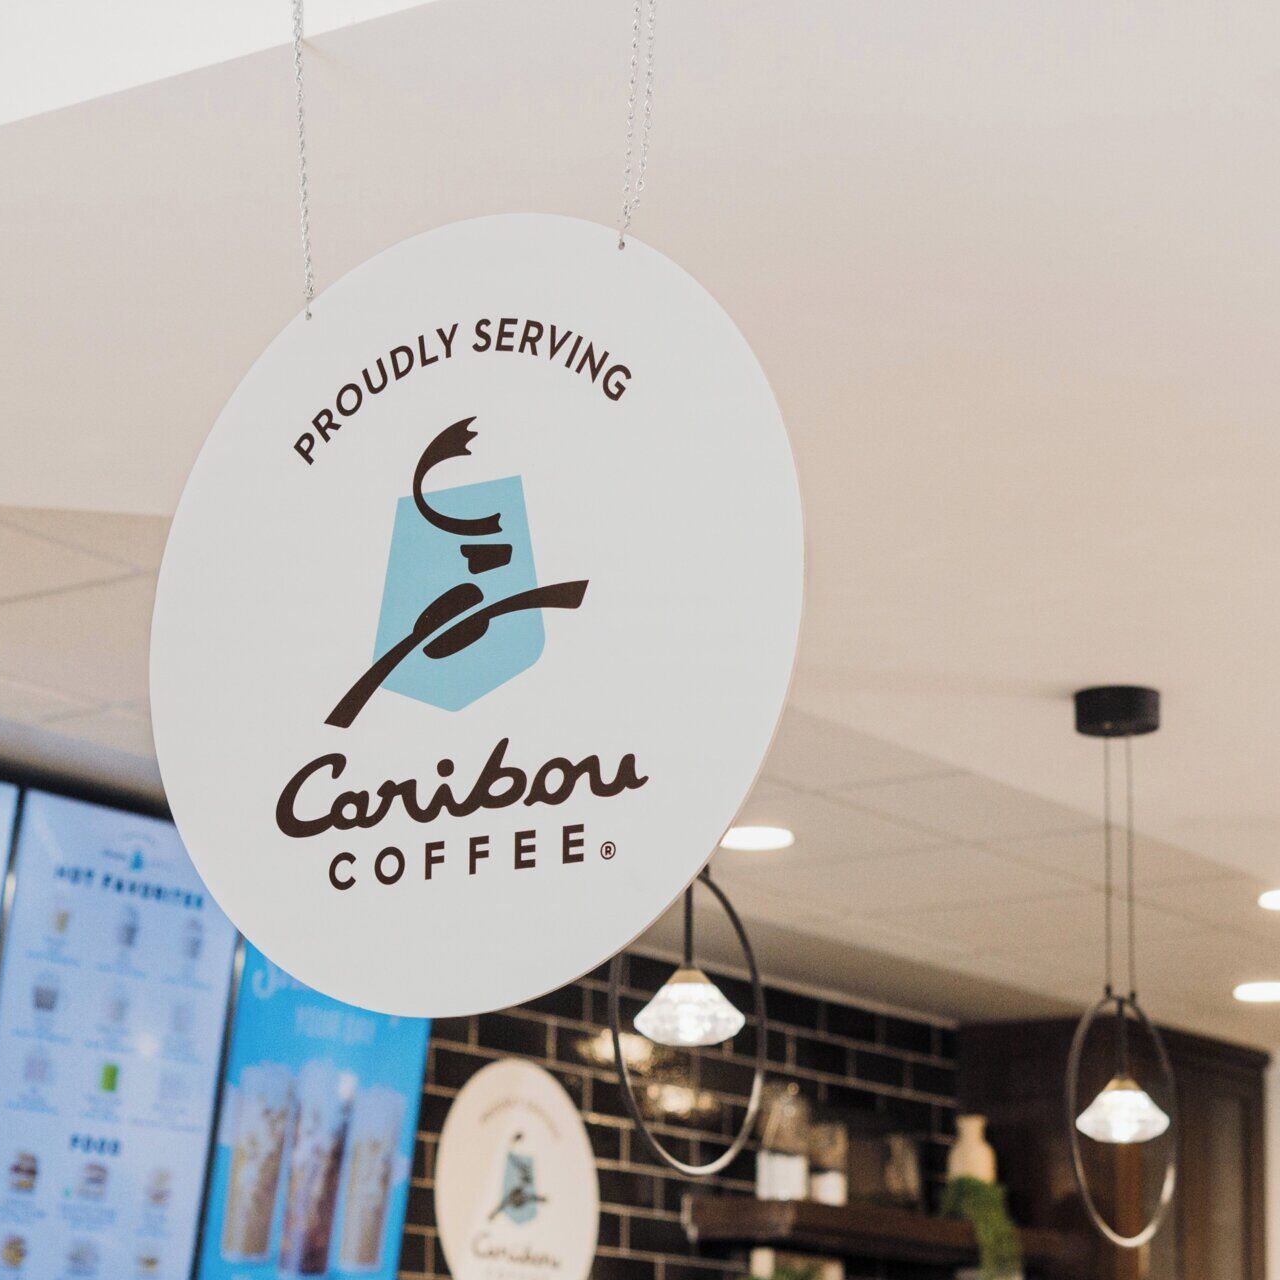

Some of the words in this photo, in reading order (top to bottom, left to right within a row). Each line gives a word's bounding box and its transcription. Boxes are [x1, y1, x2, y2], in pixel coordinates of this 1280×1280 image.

[293, 322, 459, 466] PROUDLY
[471, 317, 633, 402] SERVING
[275, 737, 649, 839] Caribou
